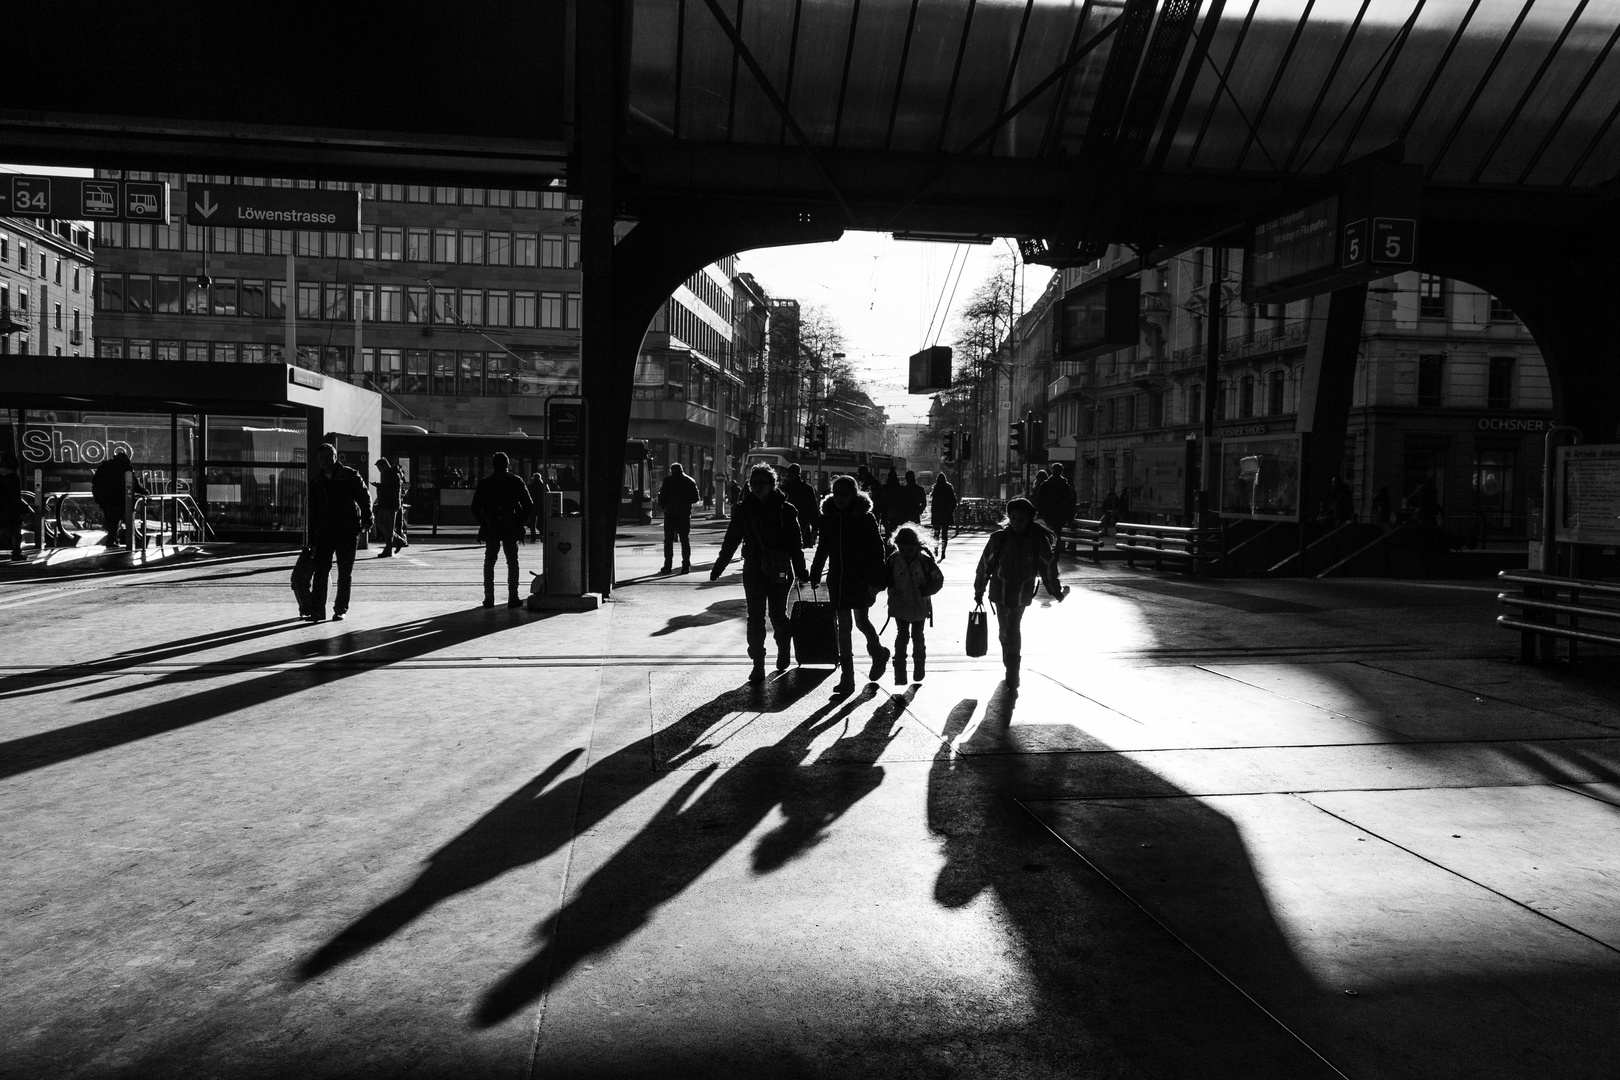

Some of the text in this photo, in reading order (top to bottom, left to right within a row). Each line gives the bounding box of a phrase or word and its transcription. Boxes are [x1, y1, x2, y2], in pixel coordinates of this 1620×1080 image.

[16, 191, 47, 210] 34
[238, 207, 337, 224] Löwenstrasse
[1350, 238, 1359, 261] 5
[1385, 236, 1401, 258] 5
[1478, 418, 1543, 431] OCHSNER
